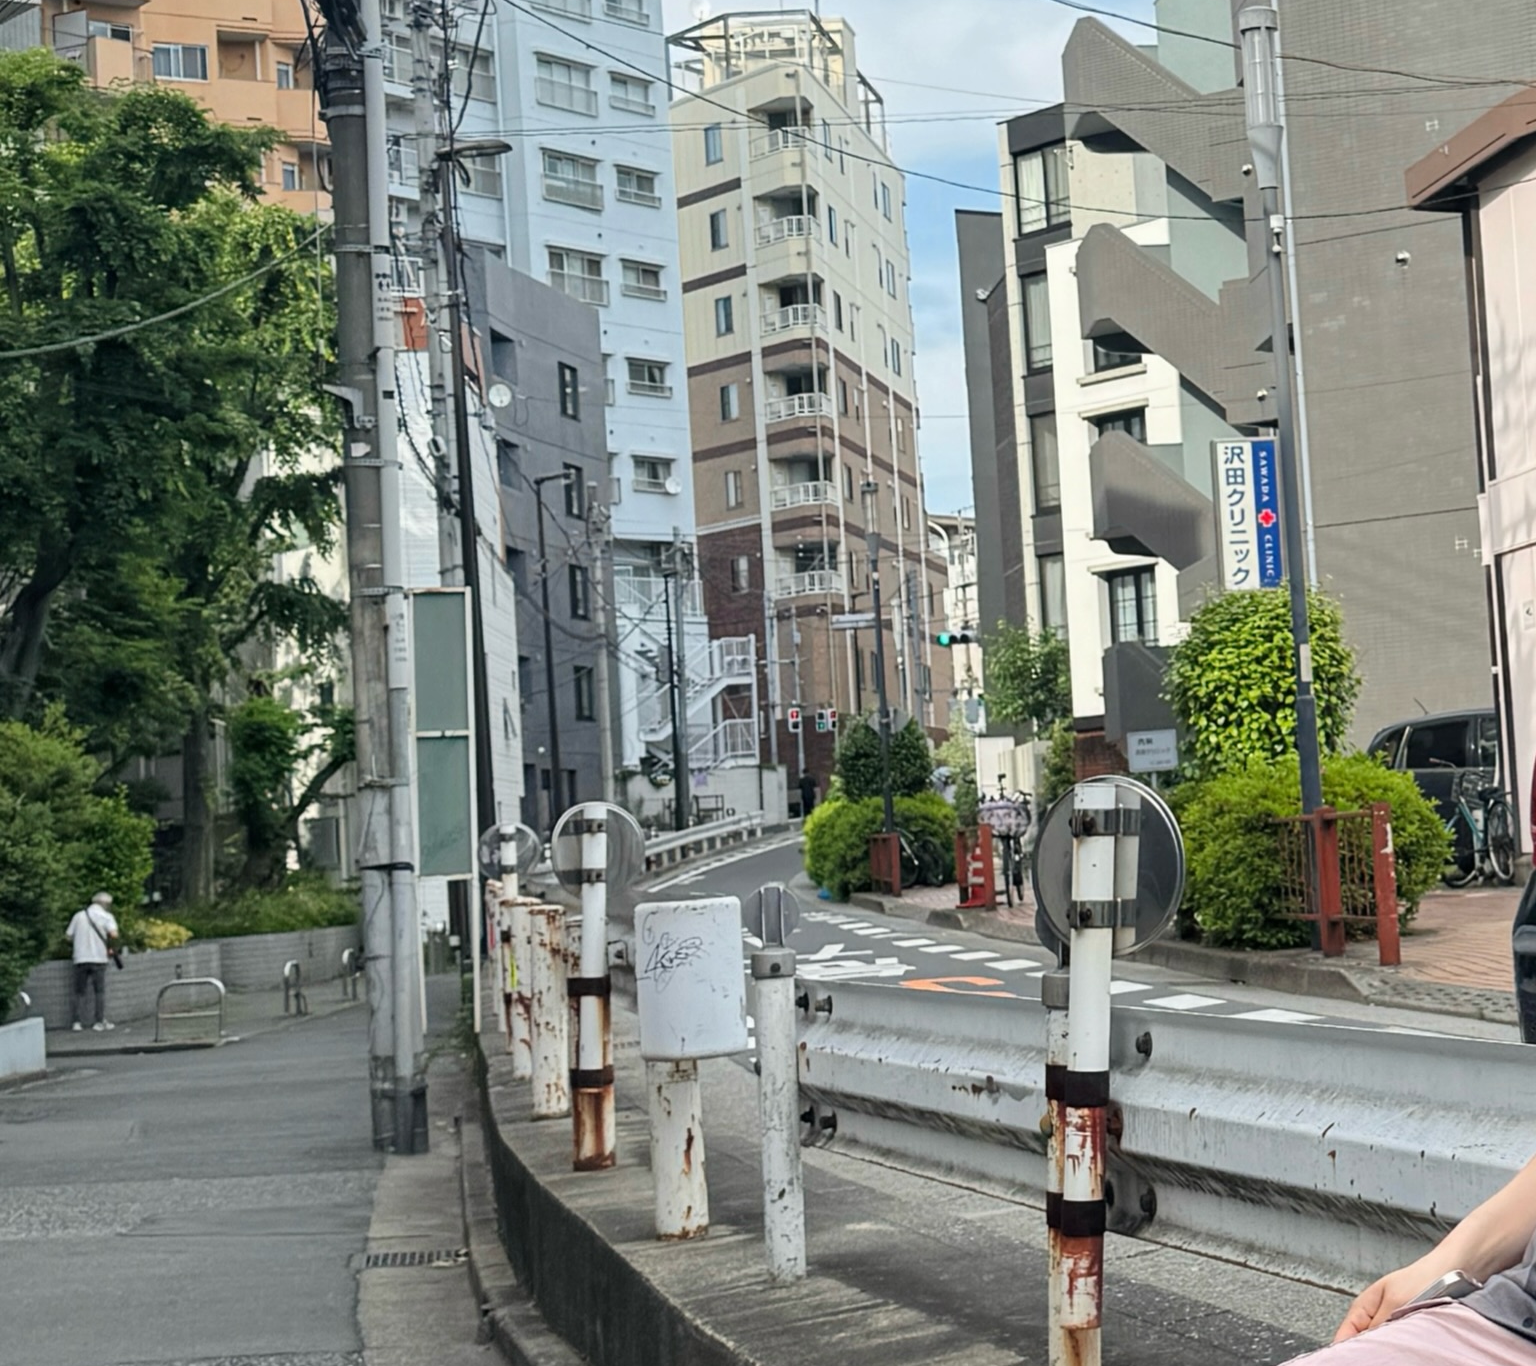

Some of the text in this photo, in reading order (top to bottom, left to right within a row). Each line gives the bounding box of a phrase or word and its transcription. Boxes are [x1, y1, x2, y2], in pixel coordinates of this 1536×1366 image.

[1258, 451, 1271, 503] SAWADA
[1223, 445, 1251, 586] 沢田クリニック
[1263, 534, 1276, 577] CLINIC
